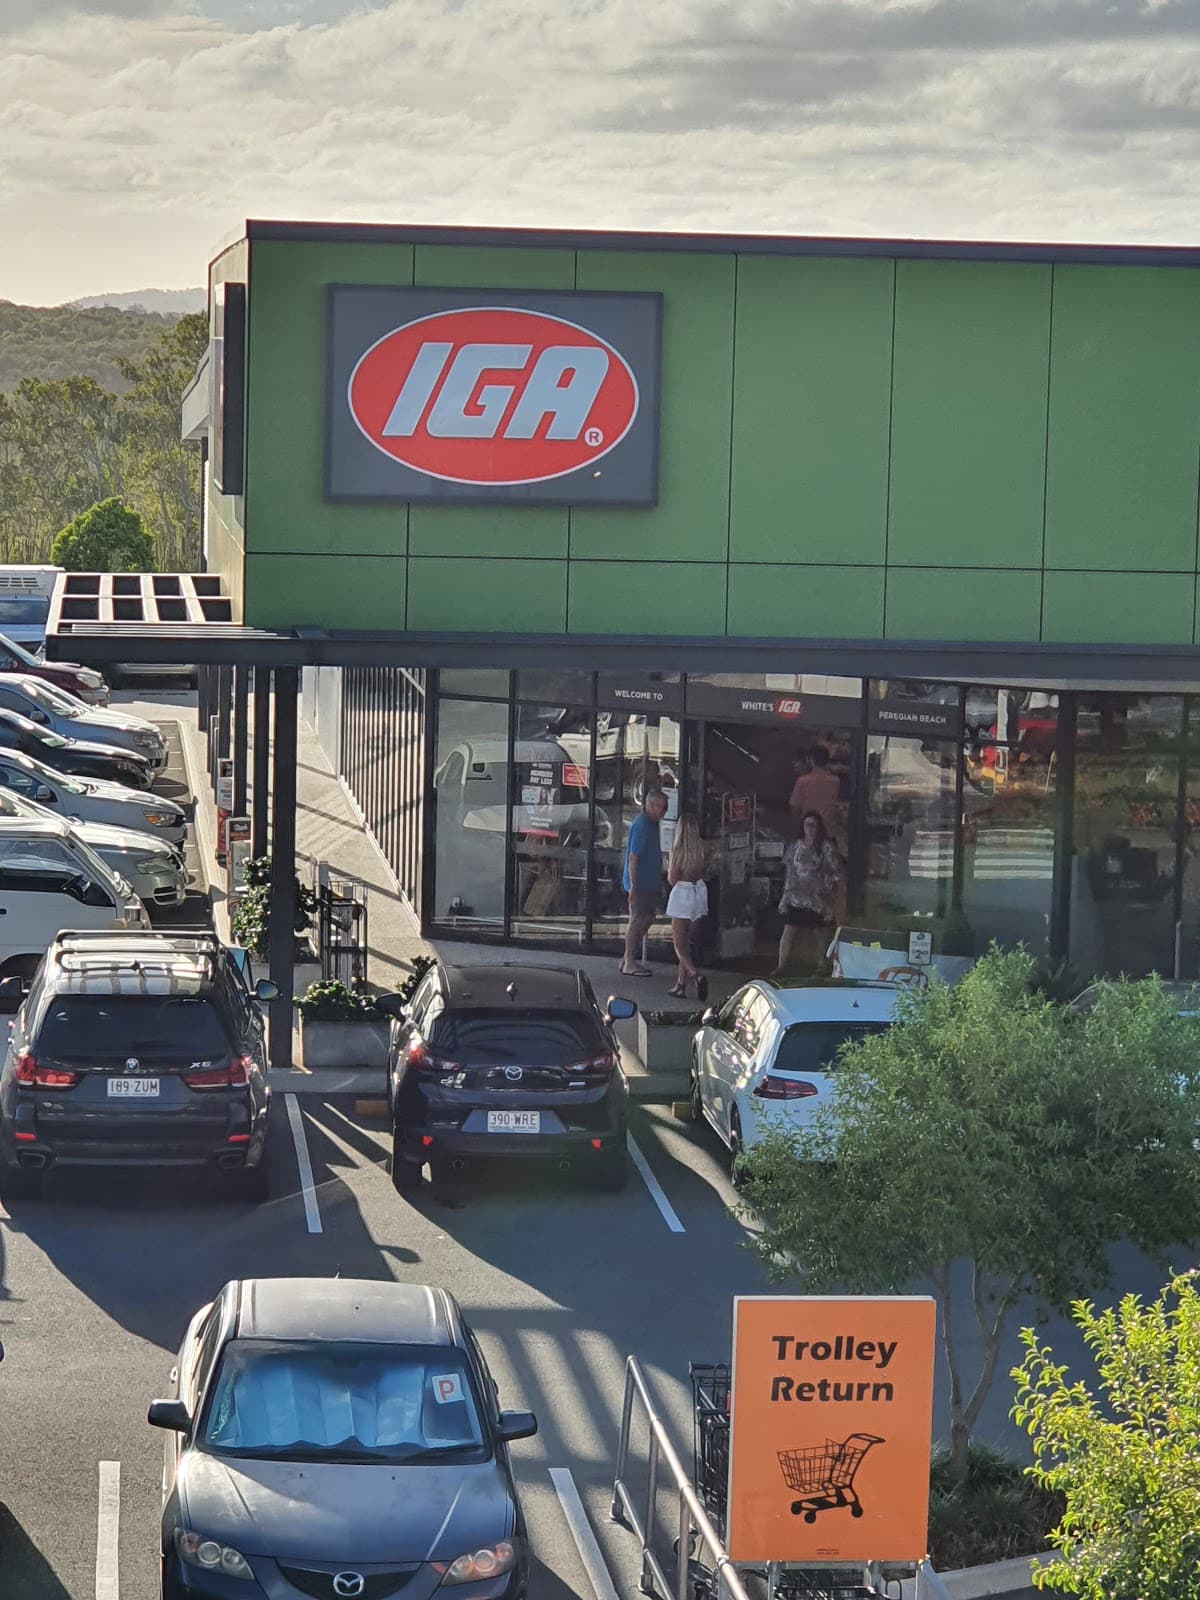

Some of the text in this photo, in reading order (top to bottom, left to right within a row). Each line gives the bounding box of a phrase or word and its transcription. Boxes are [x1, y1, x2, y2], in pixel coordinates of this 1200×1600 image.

[381, 342, 609, 440] IGA
[614, 689, 663, 700] WELCOME TO
[741, 700, 801, 713] WHITE'S IGA
[879, 711, 946, 724] PEREGIAN BEACH
[134, 1080, 158, 1092] ZUM
[490, 1113, 537, 1125] 390 WRE
[772, 1335, 898, 1369] Trolley
[438, 1379, 455, 1401] P
[770, 1376, 894, 1402] Return
